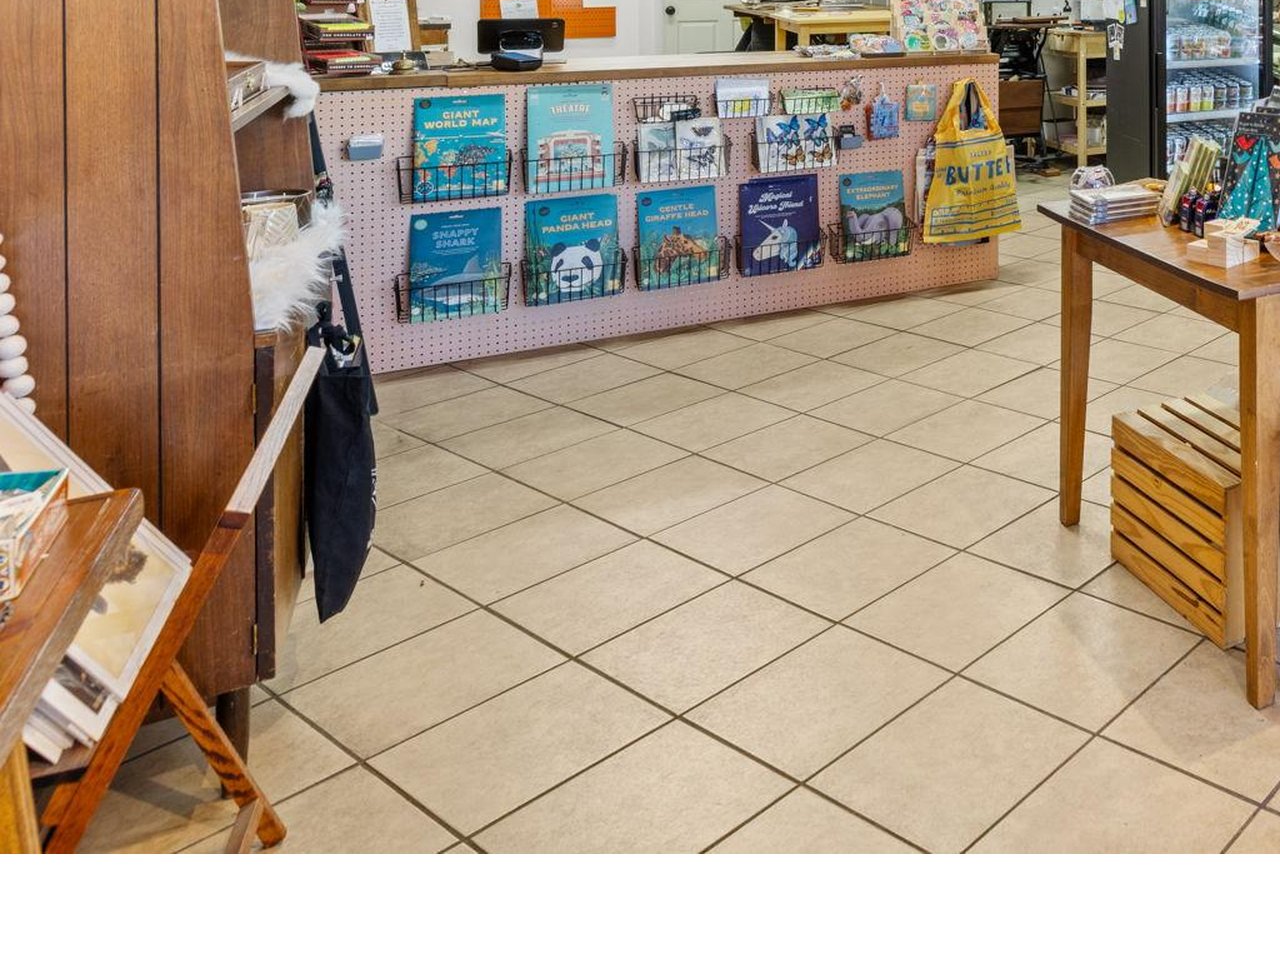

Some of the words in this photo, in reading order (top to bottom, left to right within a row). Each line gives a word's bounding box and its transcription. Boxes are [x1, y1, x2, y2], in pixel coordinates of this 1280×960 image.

[442, 109, 480, 120] GIANT
[424, 120, 468, 130] WORLD
[471, 117, 499, 127] MAP
[855, 192, 890, 201] ELEPHANT
[658, 203, 695, 213] GENTLE
[560, 212, 595, 222] GIANT
[645, 213, 682, 223] GIRAFFE
[684, 209, 709, 219] HEAD
[541, 223, 580, 234] PANDA
[581, 219, 612, 229] HEAD
[432, 228, 480, 239] SNAPPY
[435, 238, 476, 249] SHARK
